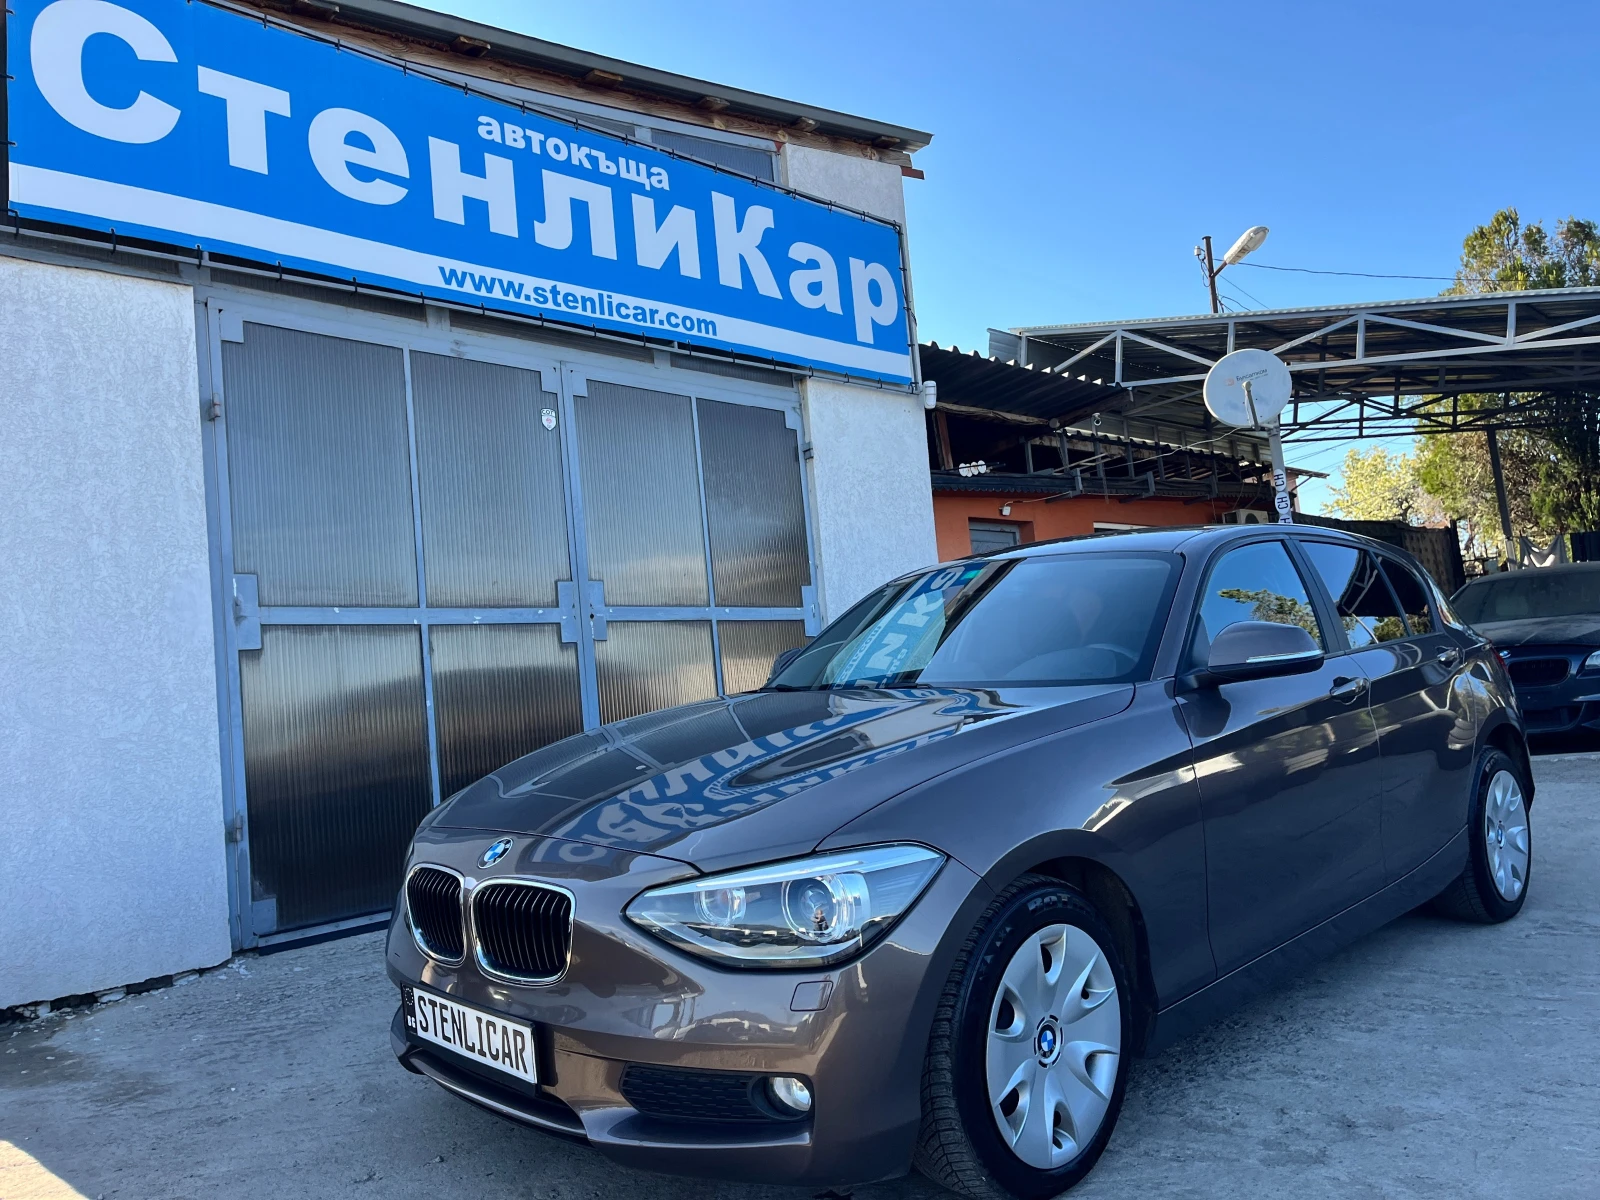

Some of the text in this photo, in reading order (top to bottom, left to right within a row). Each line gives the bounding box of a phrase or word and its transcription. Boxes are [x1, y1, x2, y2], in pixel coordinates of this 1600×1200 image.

[30, 0, 898, 344] СтенлиКар
[478, 115, 670, 191] автокъща
[438, 265, 718, 337] www.stenlicar.com
[416, 995, 529, 1075] STENLICAR
